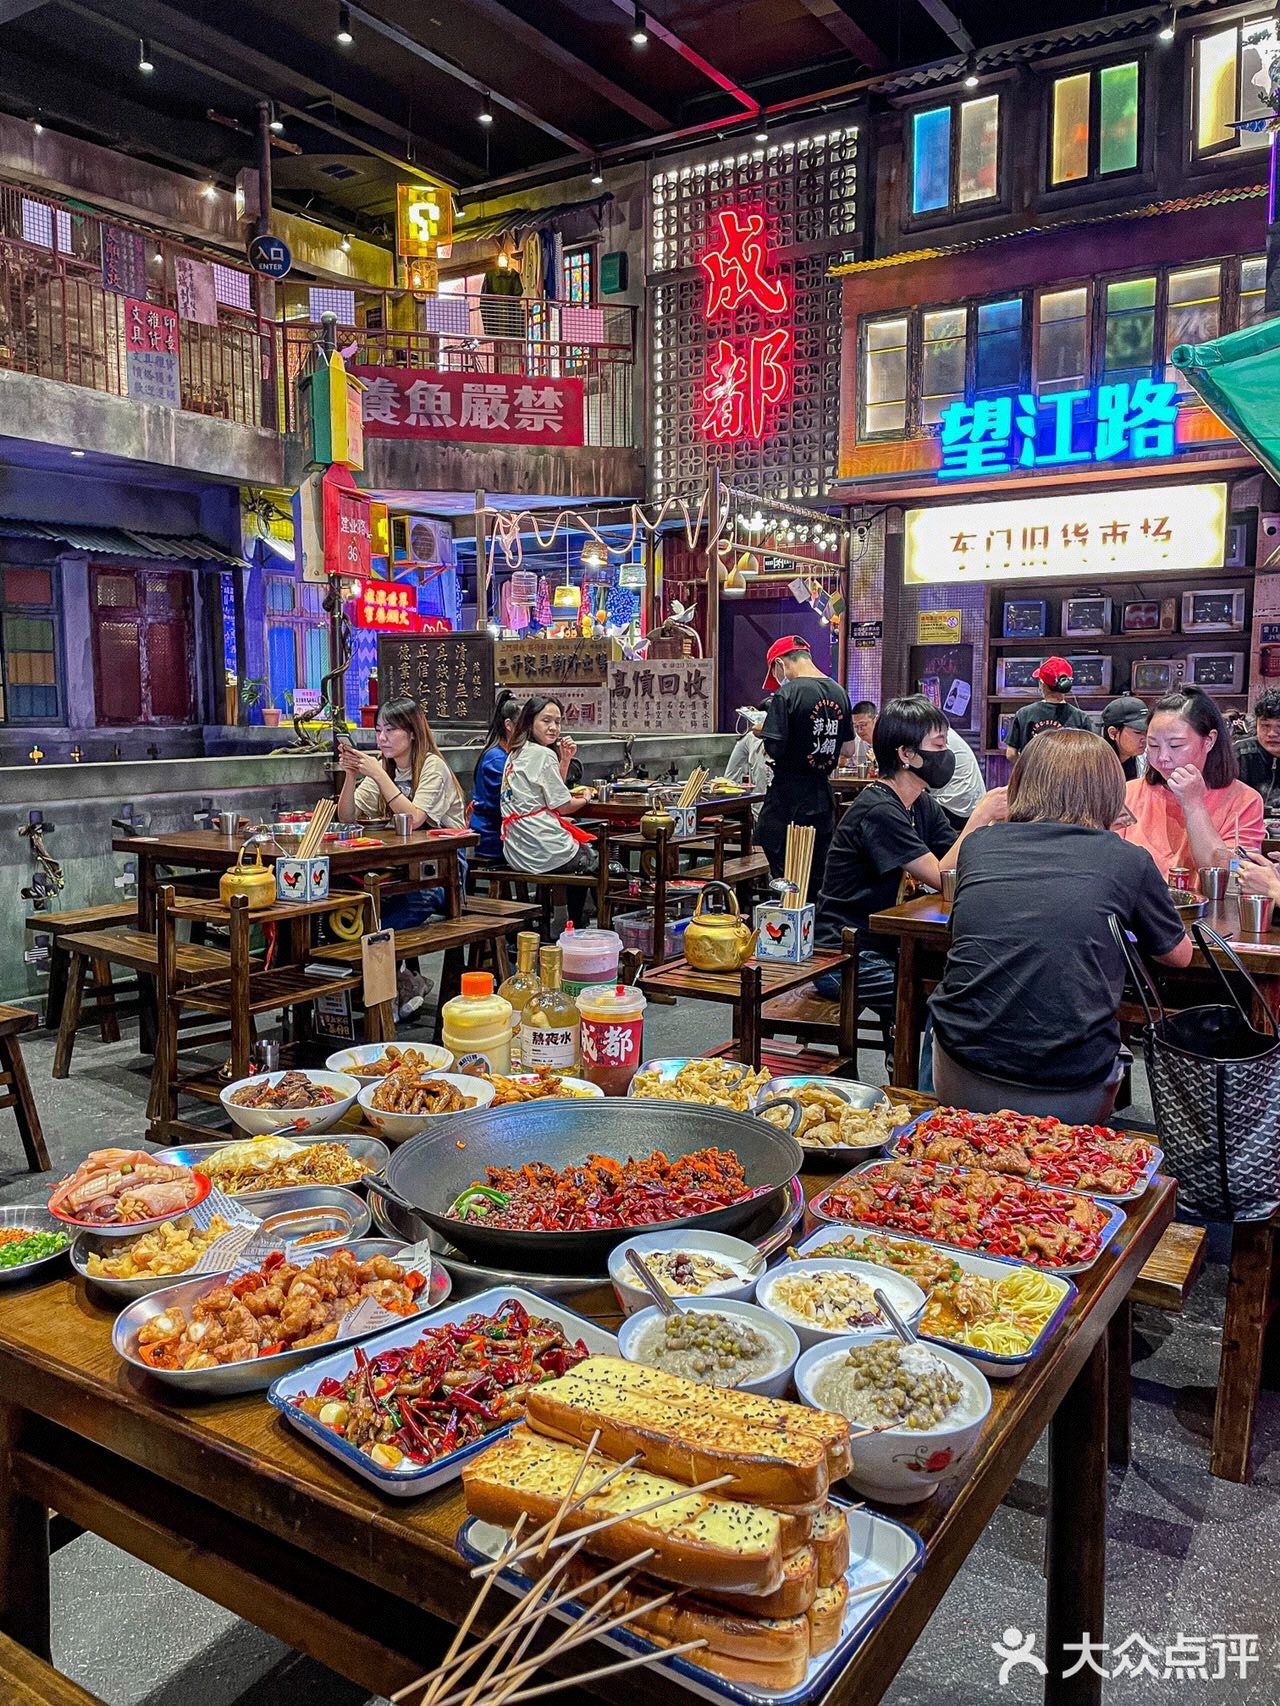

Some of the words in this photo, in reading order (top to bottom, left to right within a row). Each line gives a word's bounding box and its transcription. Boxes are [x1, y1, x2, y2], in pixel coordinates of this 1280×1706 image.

[256, 246, 284, 262] 入口
[131, 305, 144, 345] 文具
[163, 315, 176, 354] 印章
[701, 210, 788, 439] 成都
[938, 378, 1180, 478] 望江路
[347, 545, 358, 562] 36
[610, 668, 709, 699] 高價回收
[531, 1031, 572, 1046] 熬夜水
